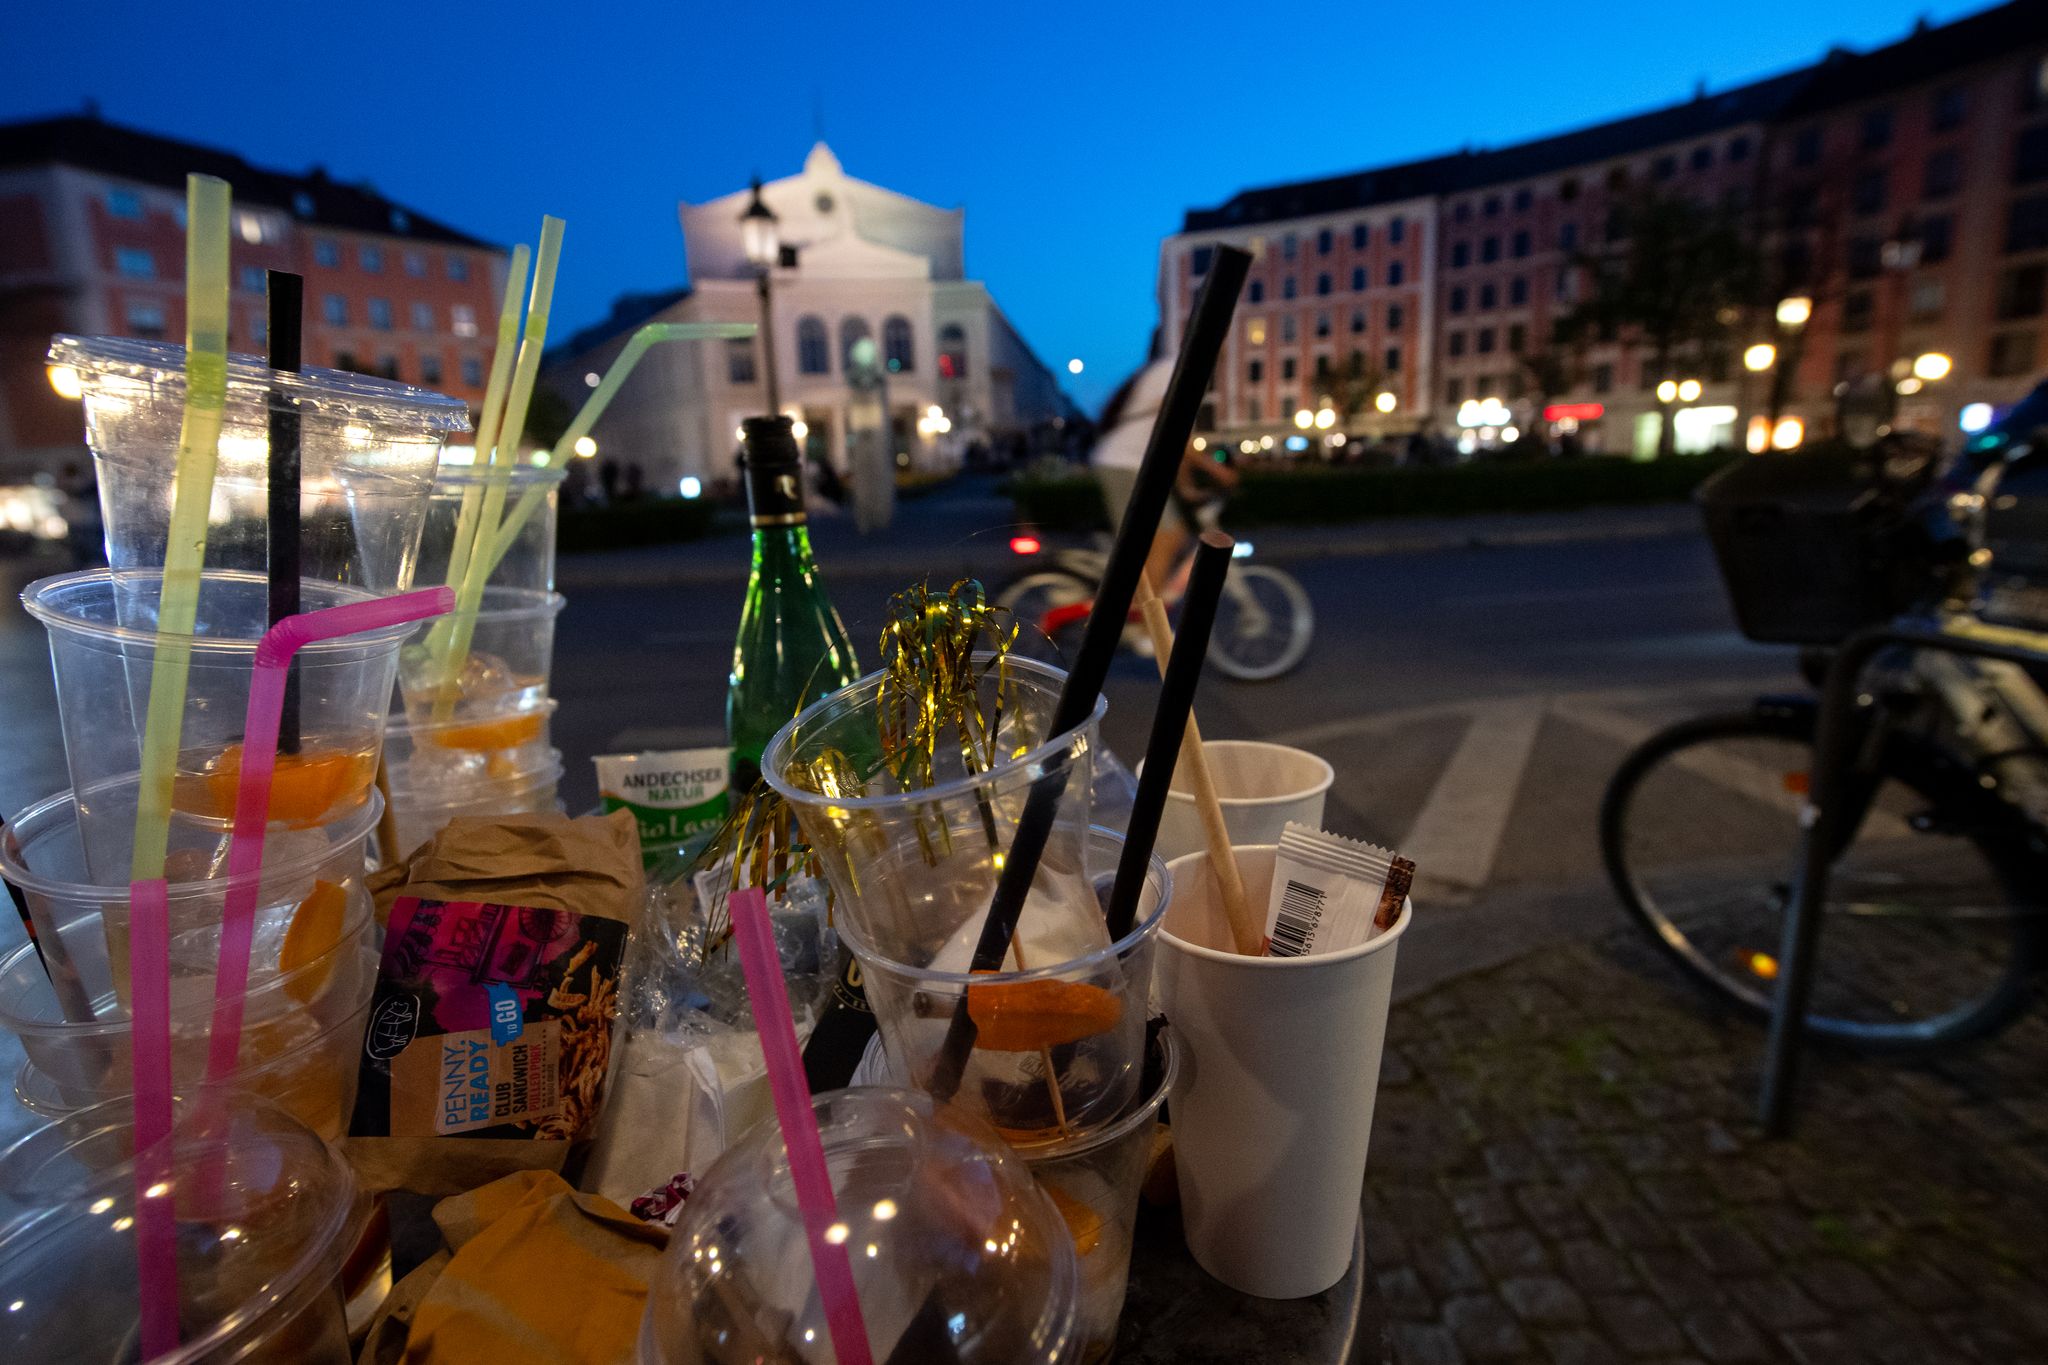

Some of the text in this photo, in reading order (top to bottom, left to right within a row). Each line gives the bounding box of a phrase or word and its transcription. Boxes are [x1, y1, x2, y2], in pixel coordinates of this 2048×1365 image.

[623, 769, 722, 788] ANDECHSER
[648, 786, 704, 801] NATUR
[495, 999, 518, 1023] GO
[444, 1040, 467, 1126] PENNY.
[468, 1040, 490, 1122] READY
[495, 1082, 511, 1117] CLUB
[512, 1043, 528, 1114] SANDWICH
[529, 1043, 542, 1112] PULLED PORK
